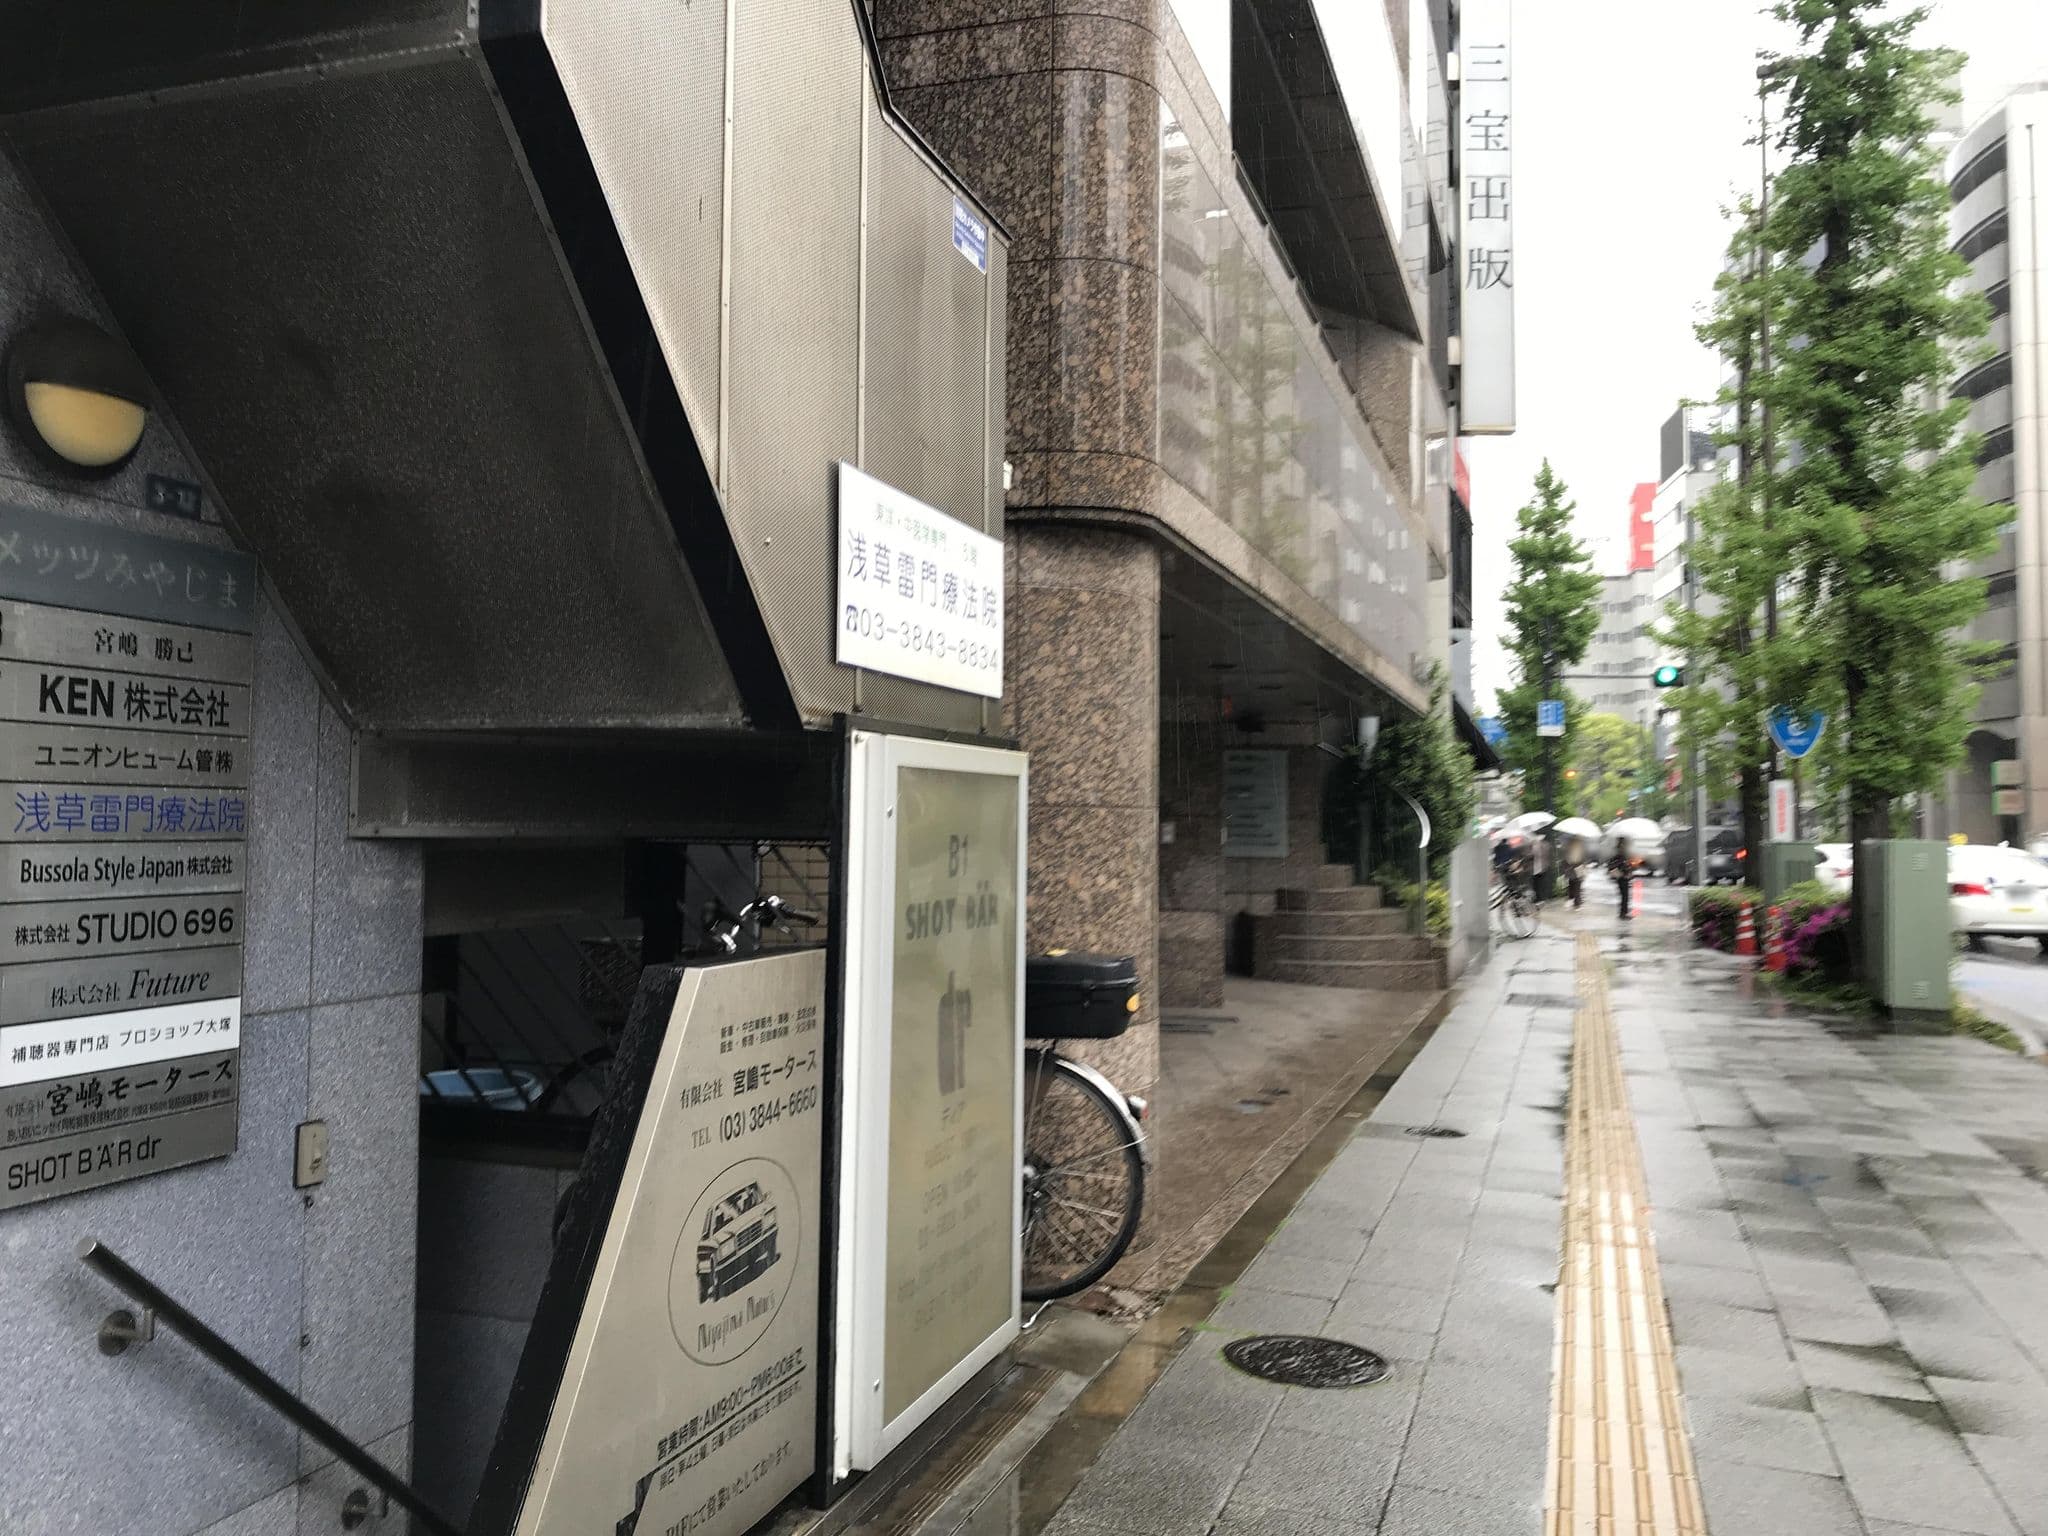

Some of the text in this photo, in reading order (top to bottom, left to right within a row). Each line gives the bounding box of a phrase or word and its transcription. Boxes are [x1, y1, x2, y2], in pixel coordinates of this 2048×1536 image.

[1464, 42, 1514, 291] 三宝出版
[847, 527, 998, 629] 浅草雷門療法院
[40, 673, 230, 729] KEN 株式会社
[14, 791, 245, 835] 浅草雷門療法院
[20, 854, 233, 887] Bussola Style Japan 株式会社
[14, 907, 234, 947] 株式会社 STUDIO 696
[906, 898, 956, 941] SHOT
[51, 968, 210, 1009] 株式会社 Future
[11, 1016, 232, 1064] 補聴器専門店 プロショップ大塚
[47, 1058, 233, 1117] 宮嶋モータース
[680, 1077, 723, 1110] 有限会社
[691, 1126, 712, 1149] TEL
[8, 1152, 72, 1190] SHOT
